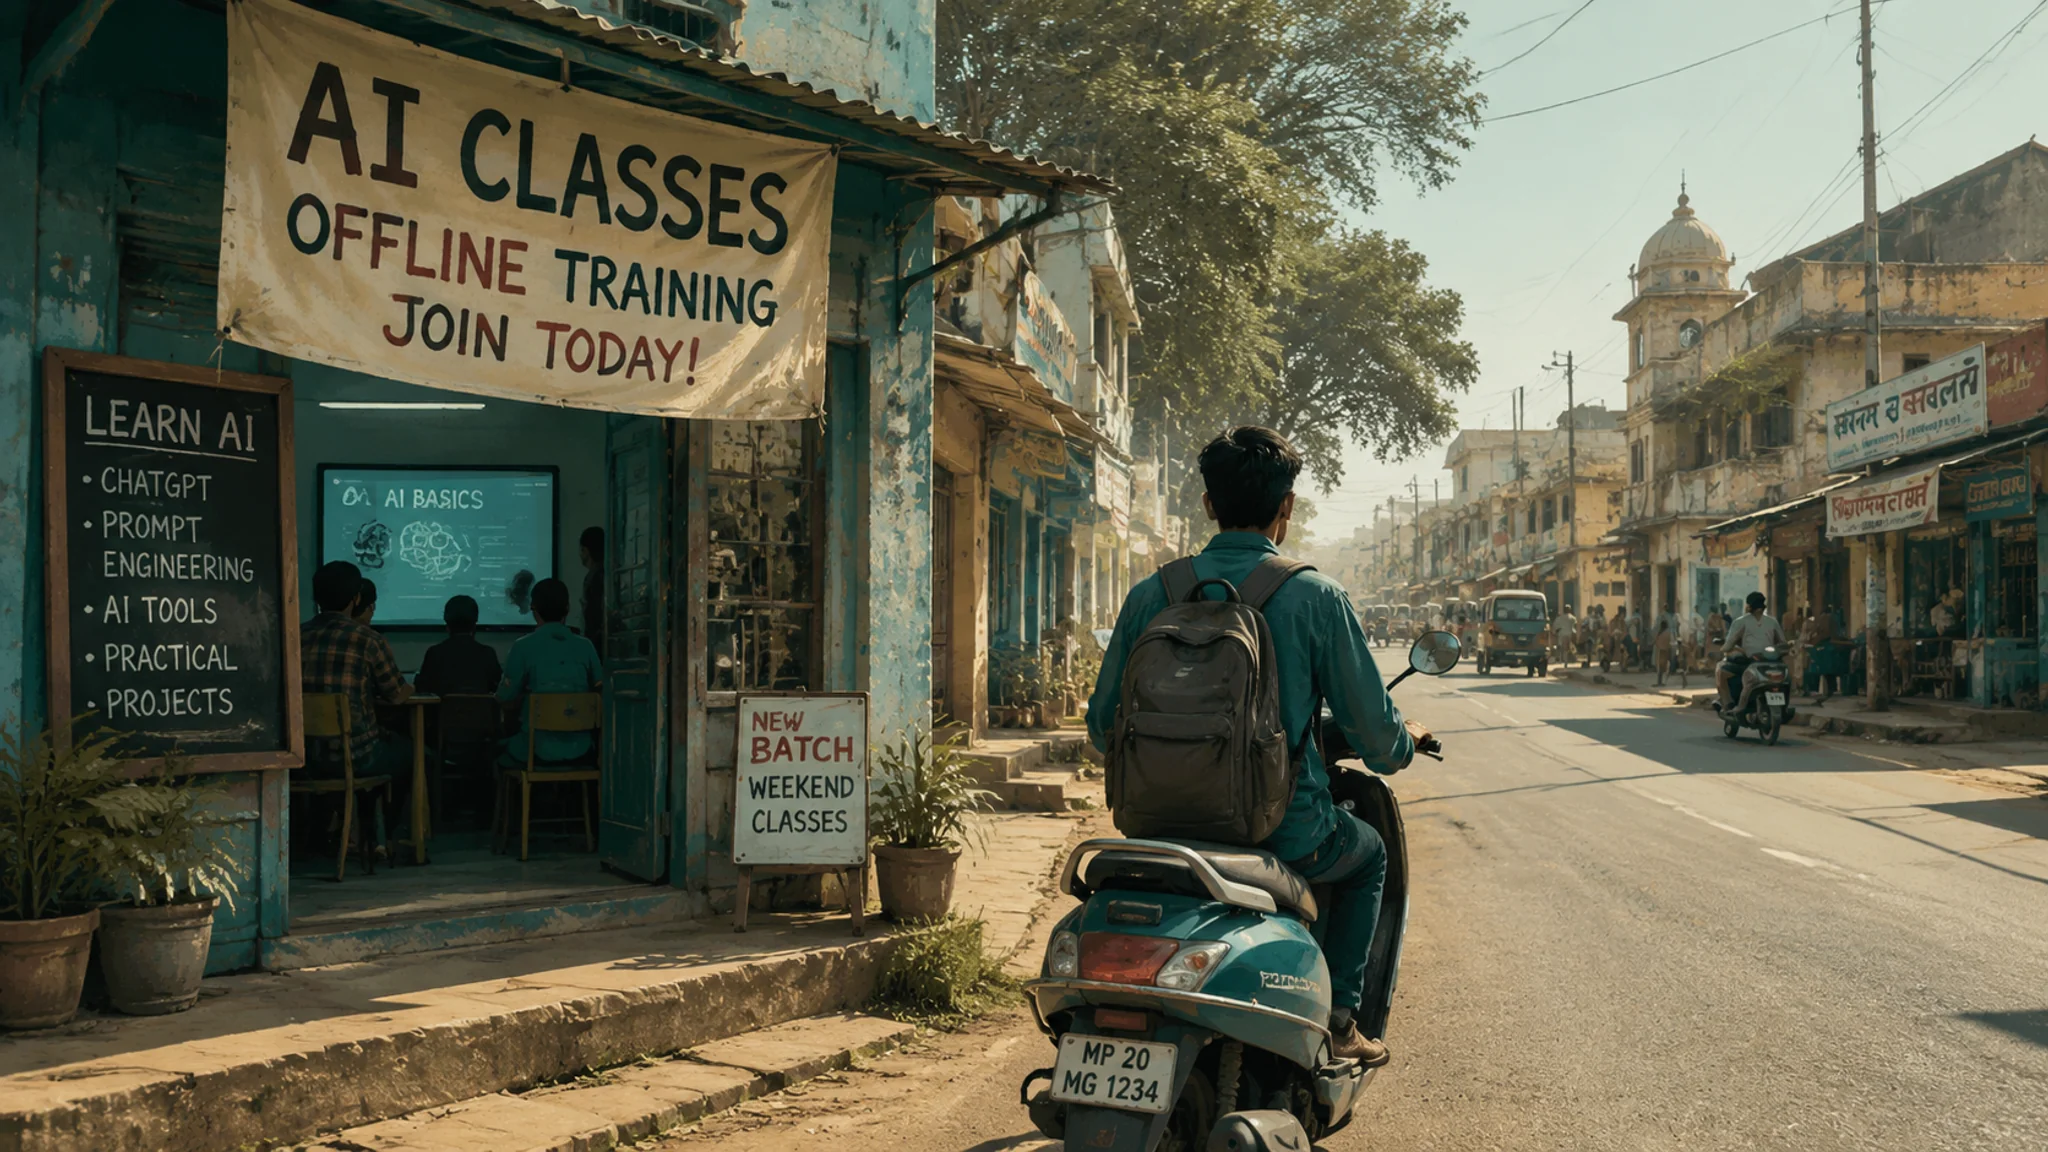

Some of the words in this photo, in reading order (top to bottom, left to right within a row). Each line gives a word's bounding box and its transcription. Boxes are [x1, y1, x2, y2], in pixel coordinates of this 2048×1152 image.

[286, 61, 420, 188] AI
[460, 108, 789, 255] CLASSES
[286, 193, 528, 295] OFFLINE
[554, 248, 778, 327] TRAINING
[383, 294, 509, 361] JOIN
[536, 321, 701, 386] TODAY!
[85, 395, 201, 446] LEARN
[218, 411, 256, 452] AI
[101, 466, 212, 501] CHATGPT
[384, 488, 404, 509] AI
[412, 488, 484, 509] BASICS
[102, 510, 203, 543] PROMPT
[103, 550, 255, 583] ENGINEERING
[103, 595, 130, 624] AI
[141, 596, 218, 625] TOOLS
[105, 642, 238, 672] PRACTICAL
[107, 688, 234, 719] PROJECTS
[752, 711, 805, 732] NEW
[750, 735, 854, 765] BATCH
[749, 774, 855, 800] WEEKEND
[752, 809, 848, 834] CLASSES
[1082, 1041, 1115, 1066] MP
[1121, 1046, 1150, 1071] 20
[1062, 1070, 1098, 1096] MG
[1106, 1074, 1159, 1103] 1234
